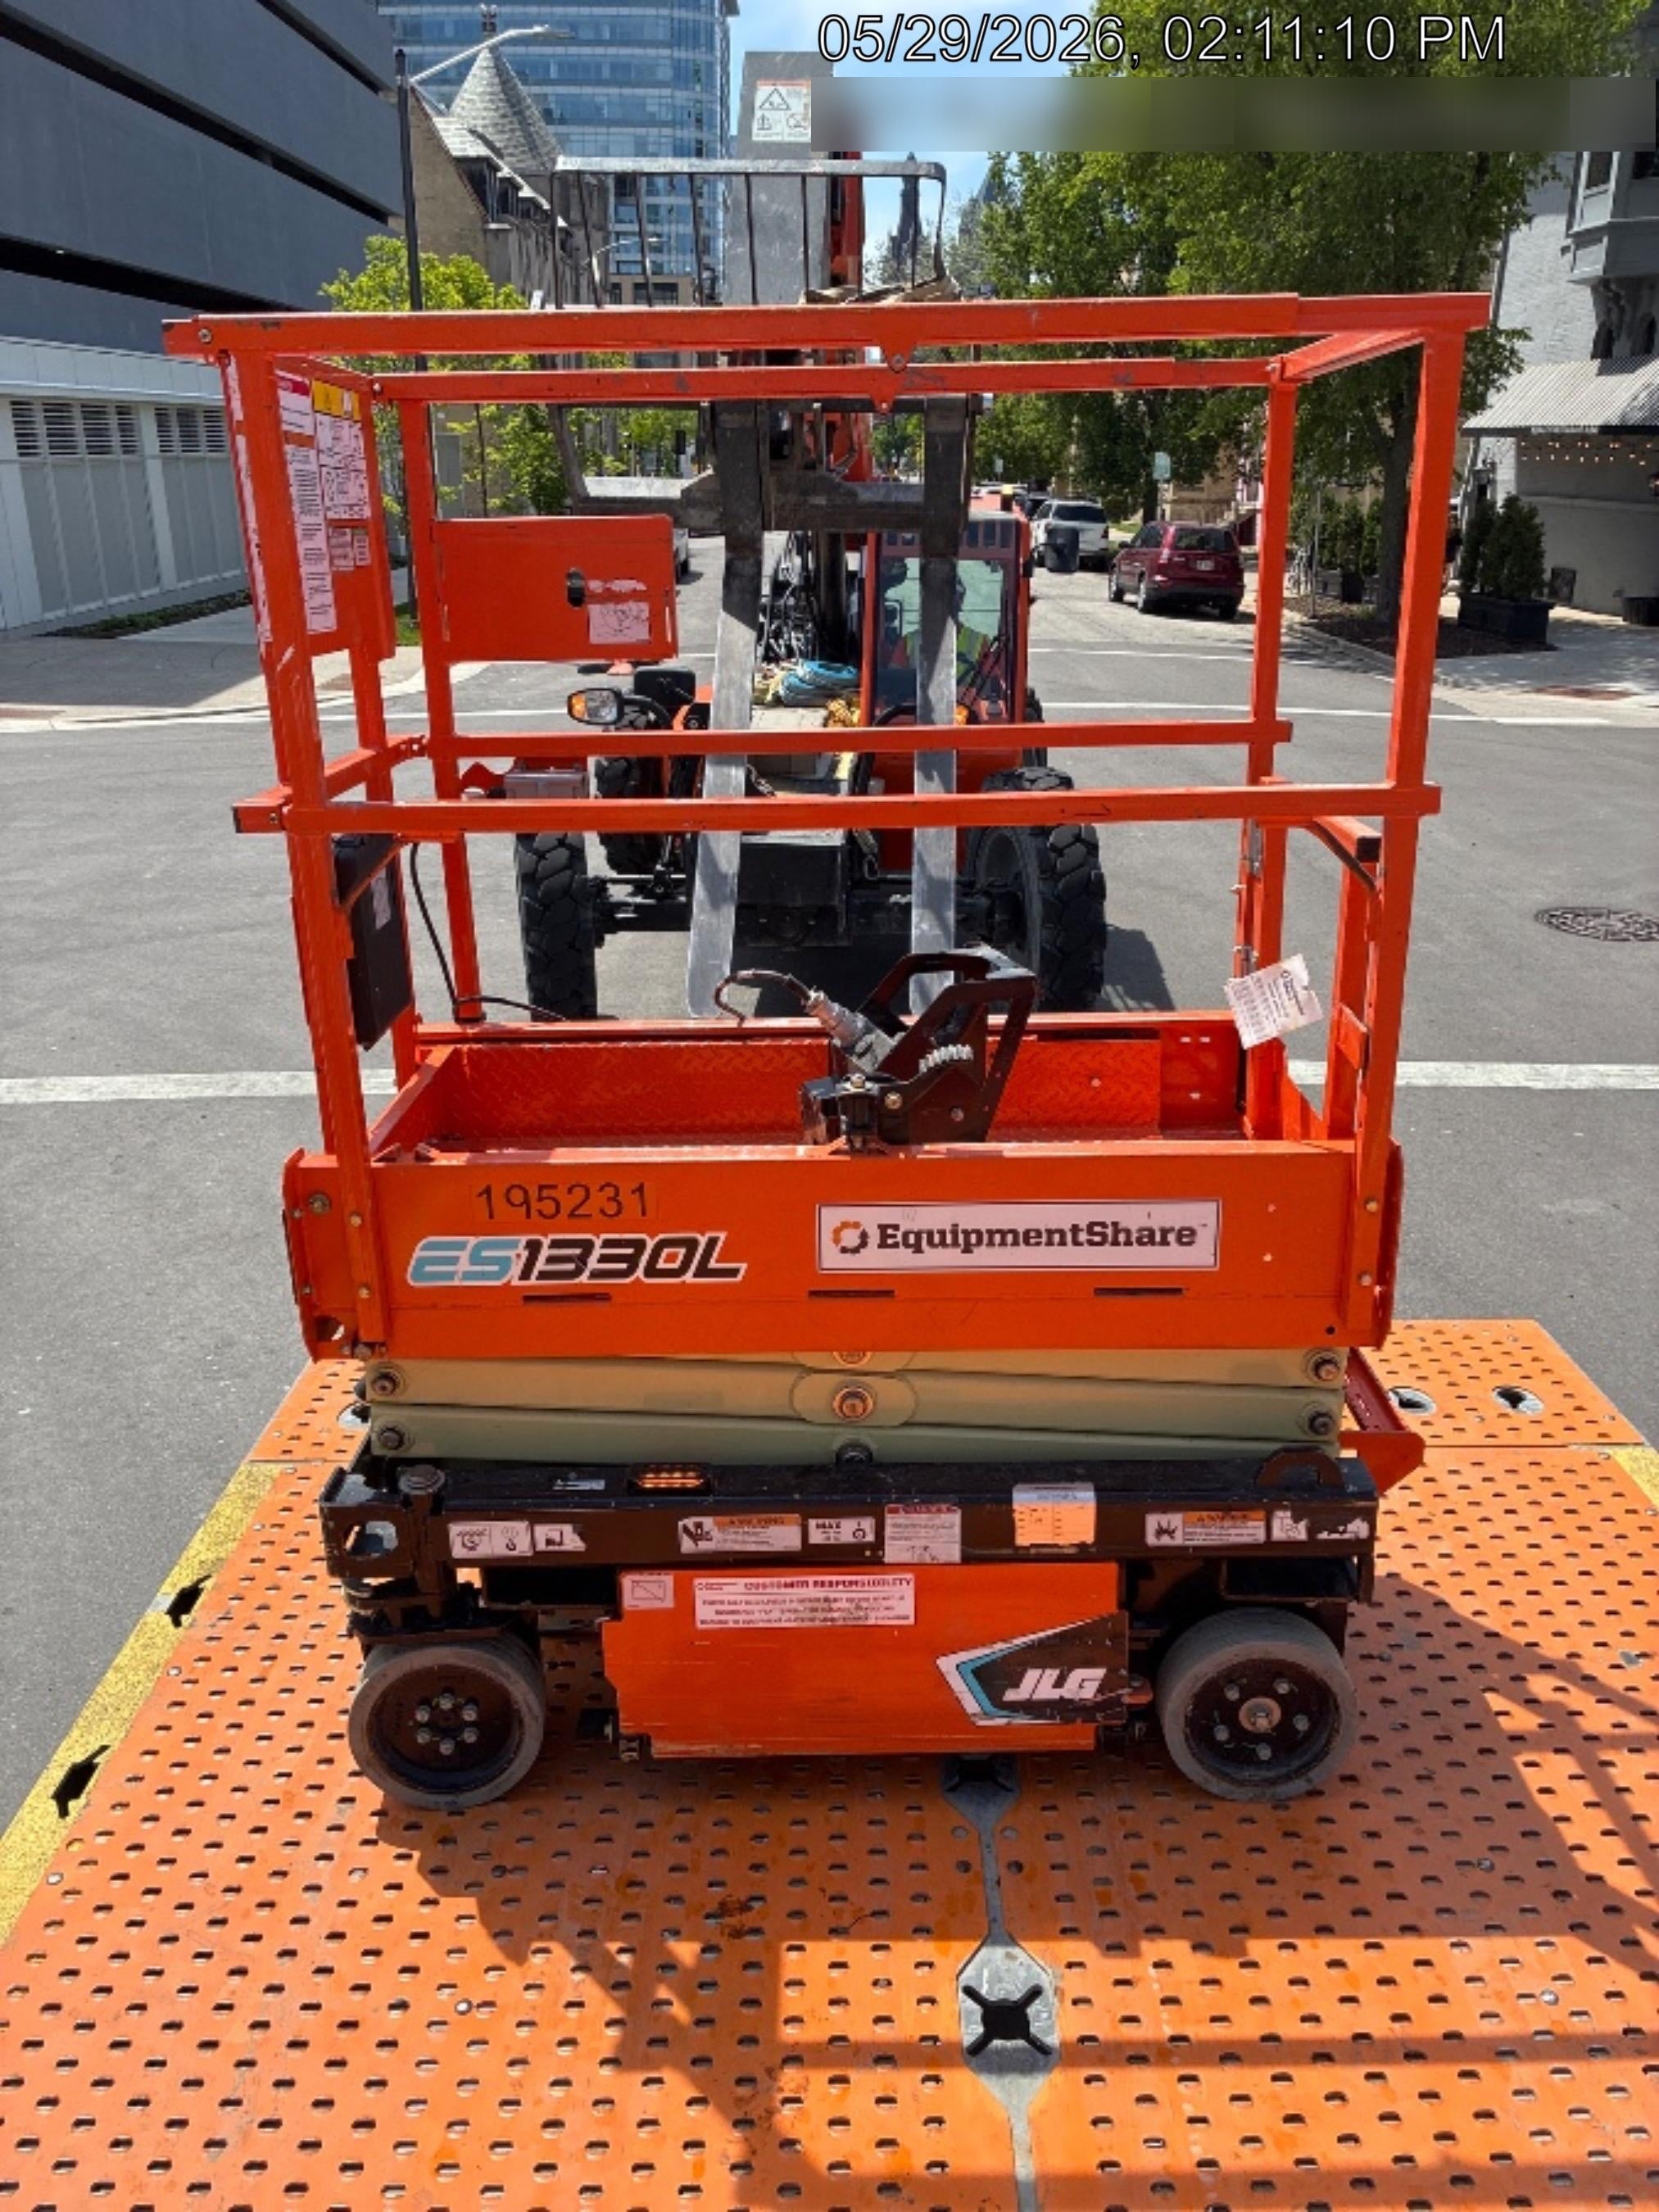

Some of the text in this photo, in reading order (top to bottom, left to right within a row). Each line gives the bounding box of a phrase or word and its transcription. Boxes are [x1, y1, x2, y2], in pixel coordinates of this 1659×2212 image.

[478, 1182, 648, 1220] 195231
[877, 1221, 1197, 1254] EquipmentShare
[408, 1233, 746, 1285] ES1330L
[1003, 1668, 1107, 1702] JLG
